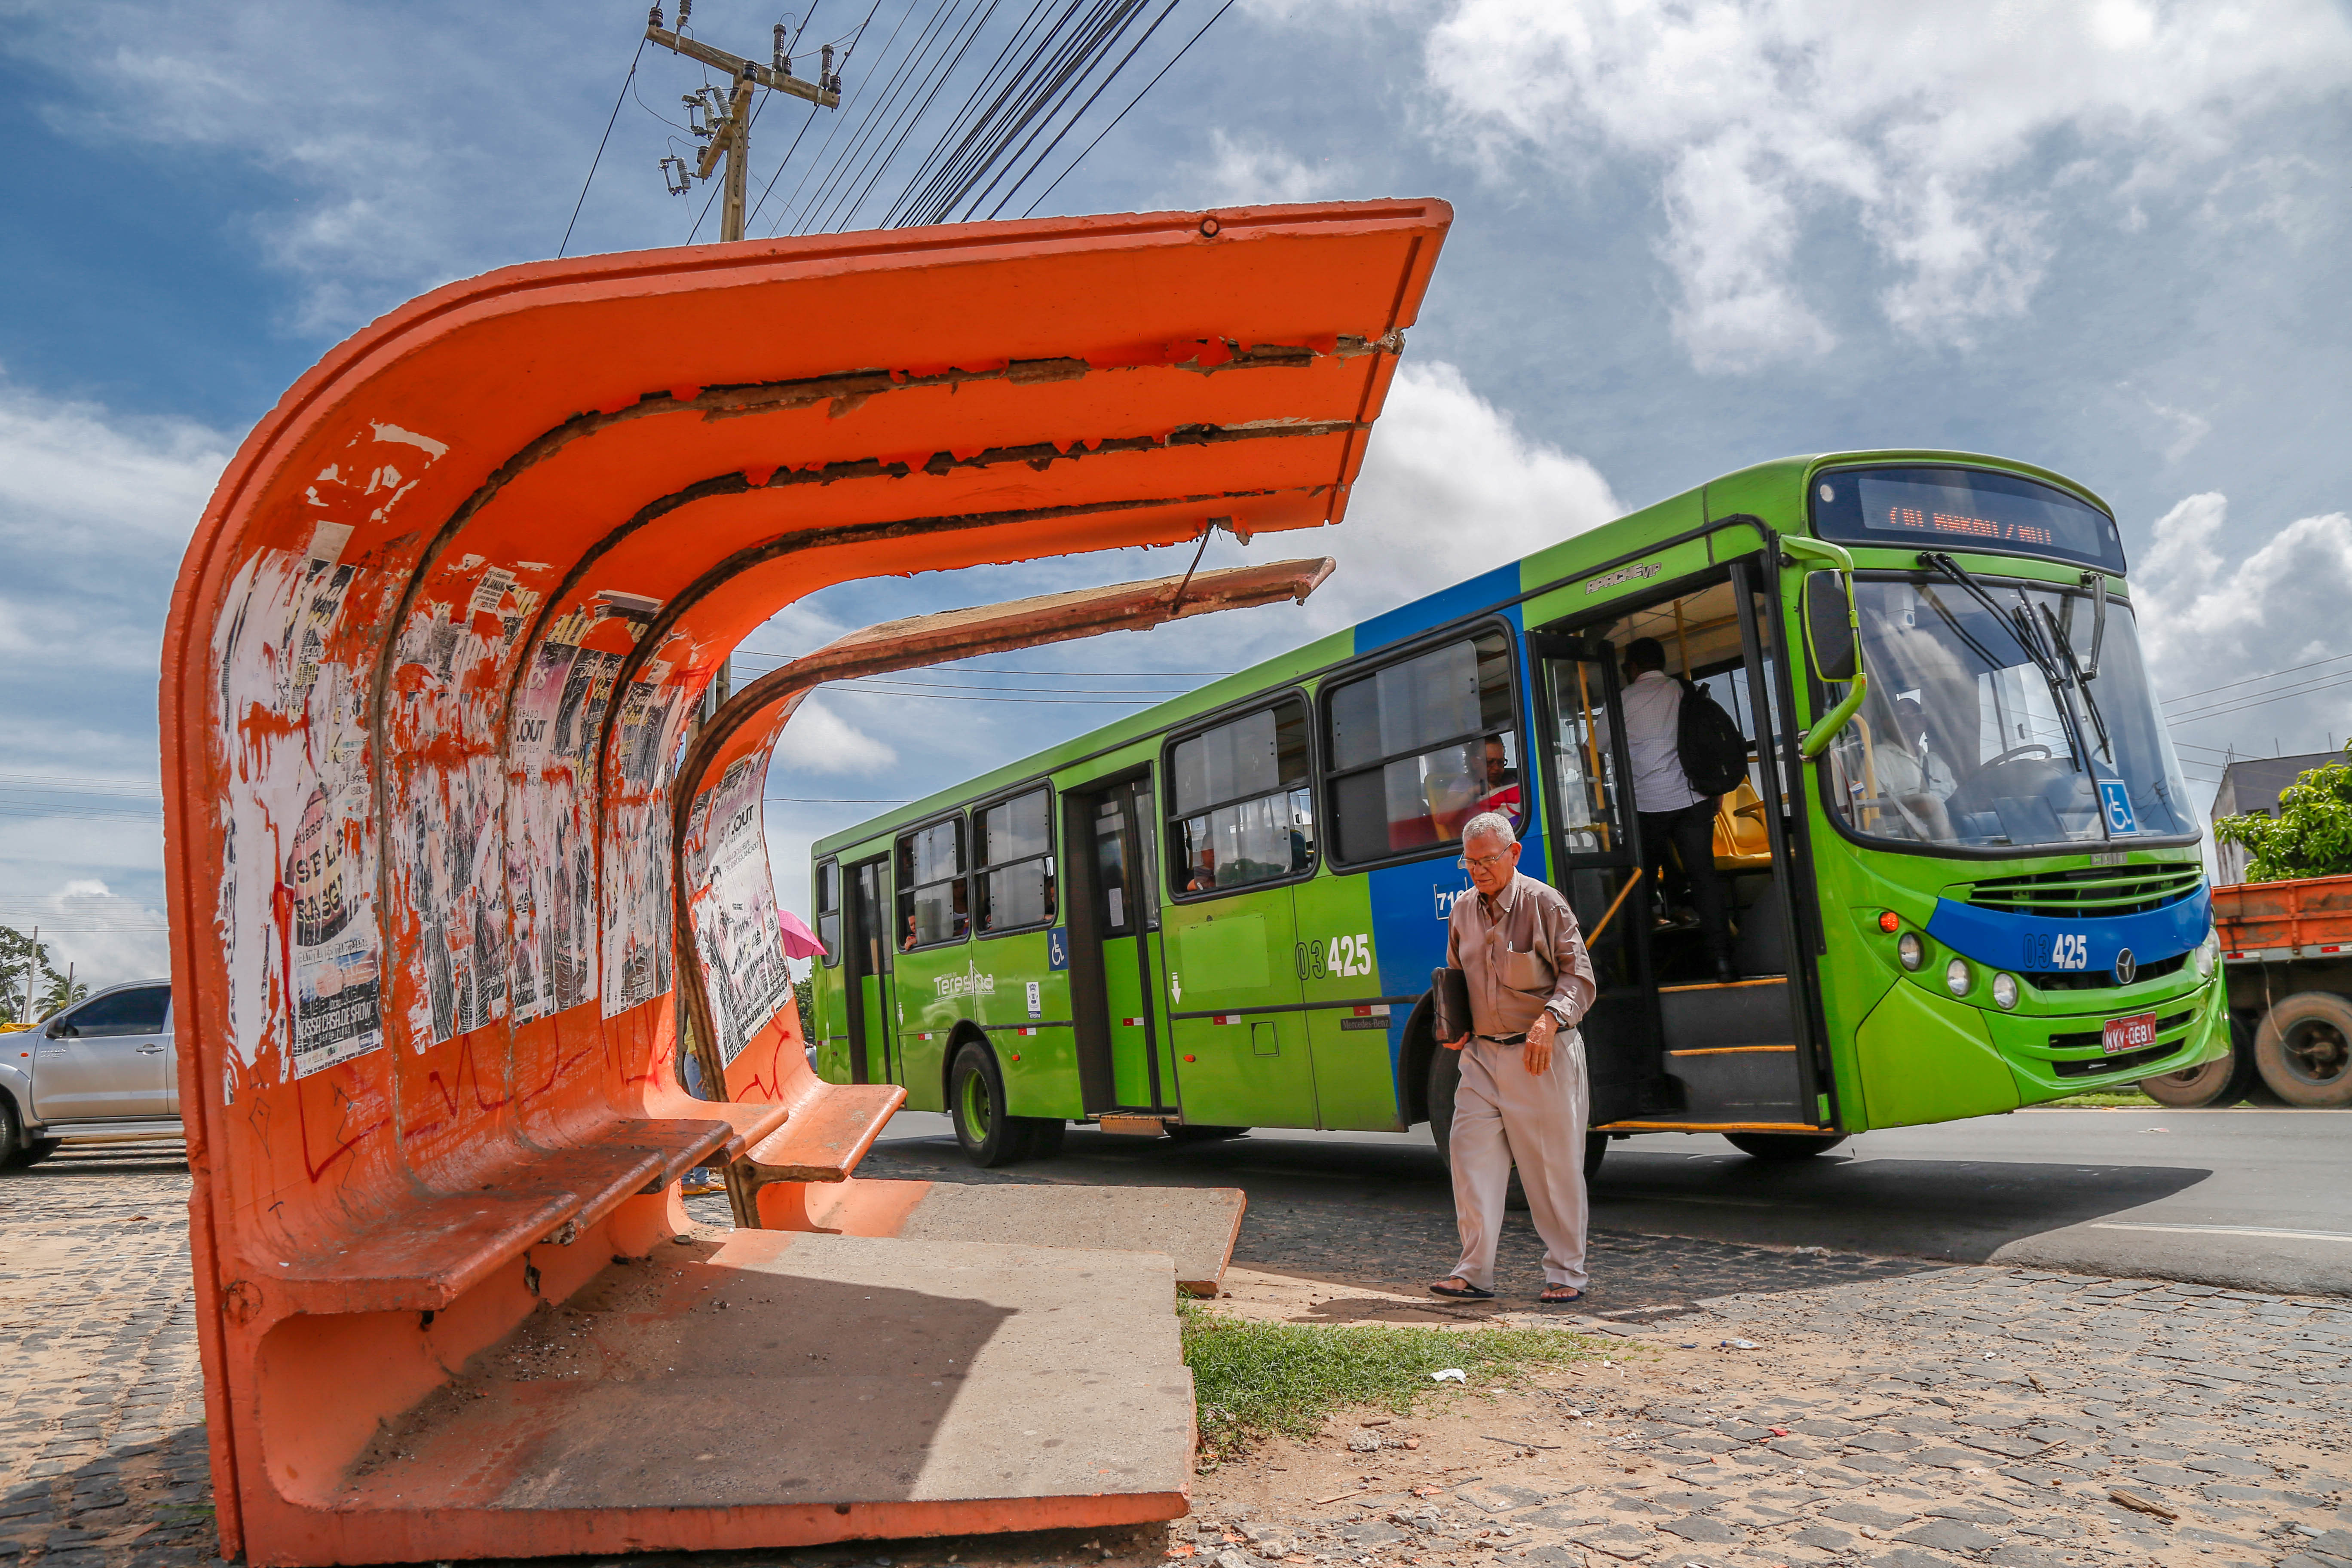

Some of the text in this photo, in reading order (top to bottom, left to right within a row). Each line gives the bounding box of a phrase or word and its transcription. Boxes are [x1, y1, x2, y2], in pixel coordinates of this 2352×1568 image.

[1586, 562, 1662, 594] APACHE VIP
[351, 1001, 371, 1023] SHOW
[1342, 1017, 1389, 1029] Mercedes-Benz
